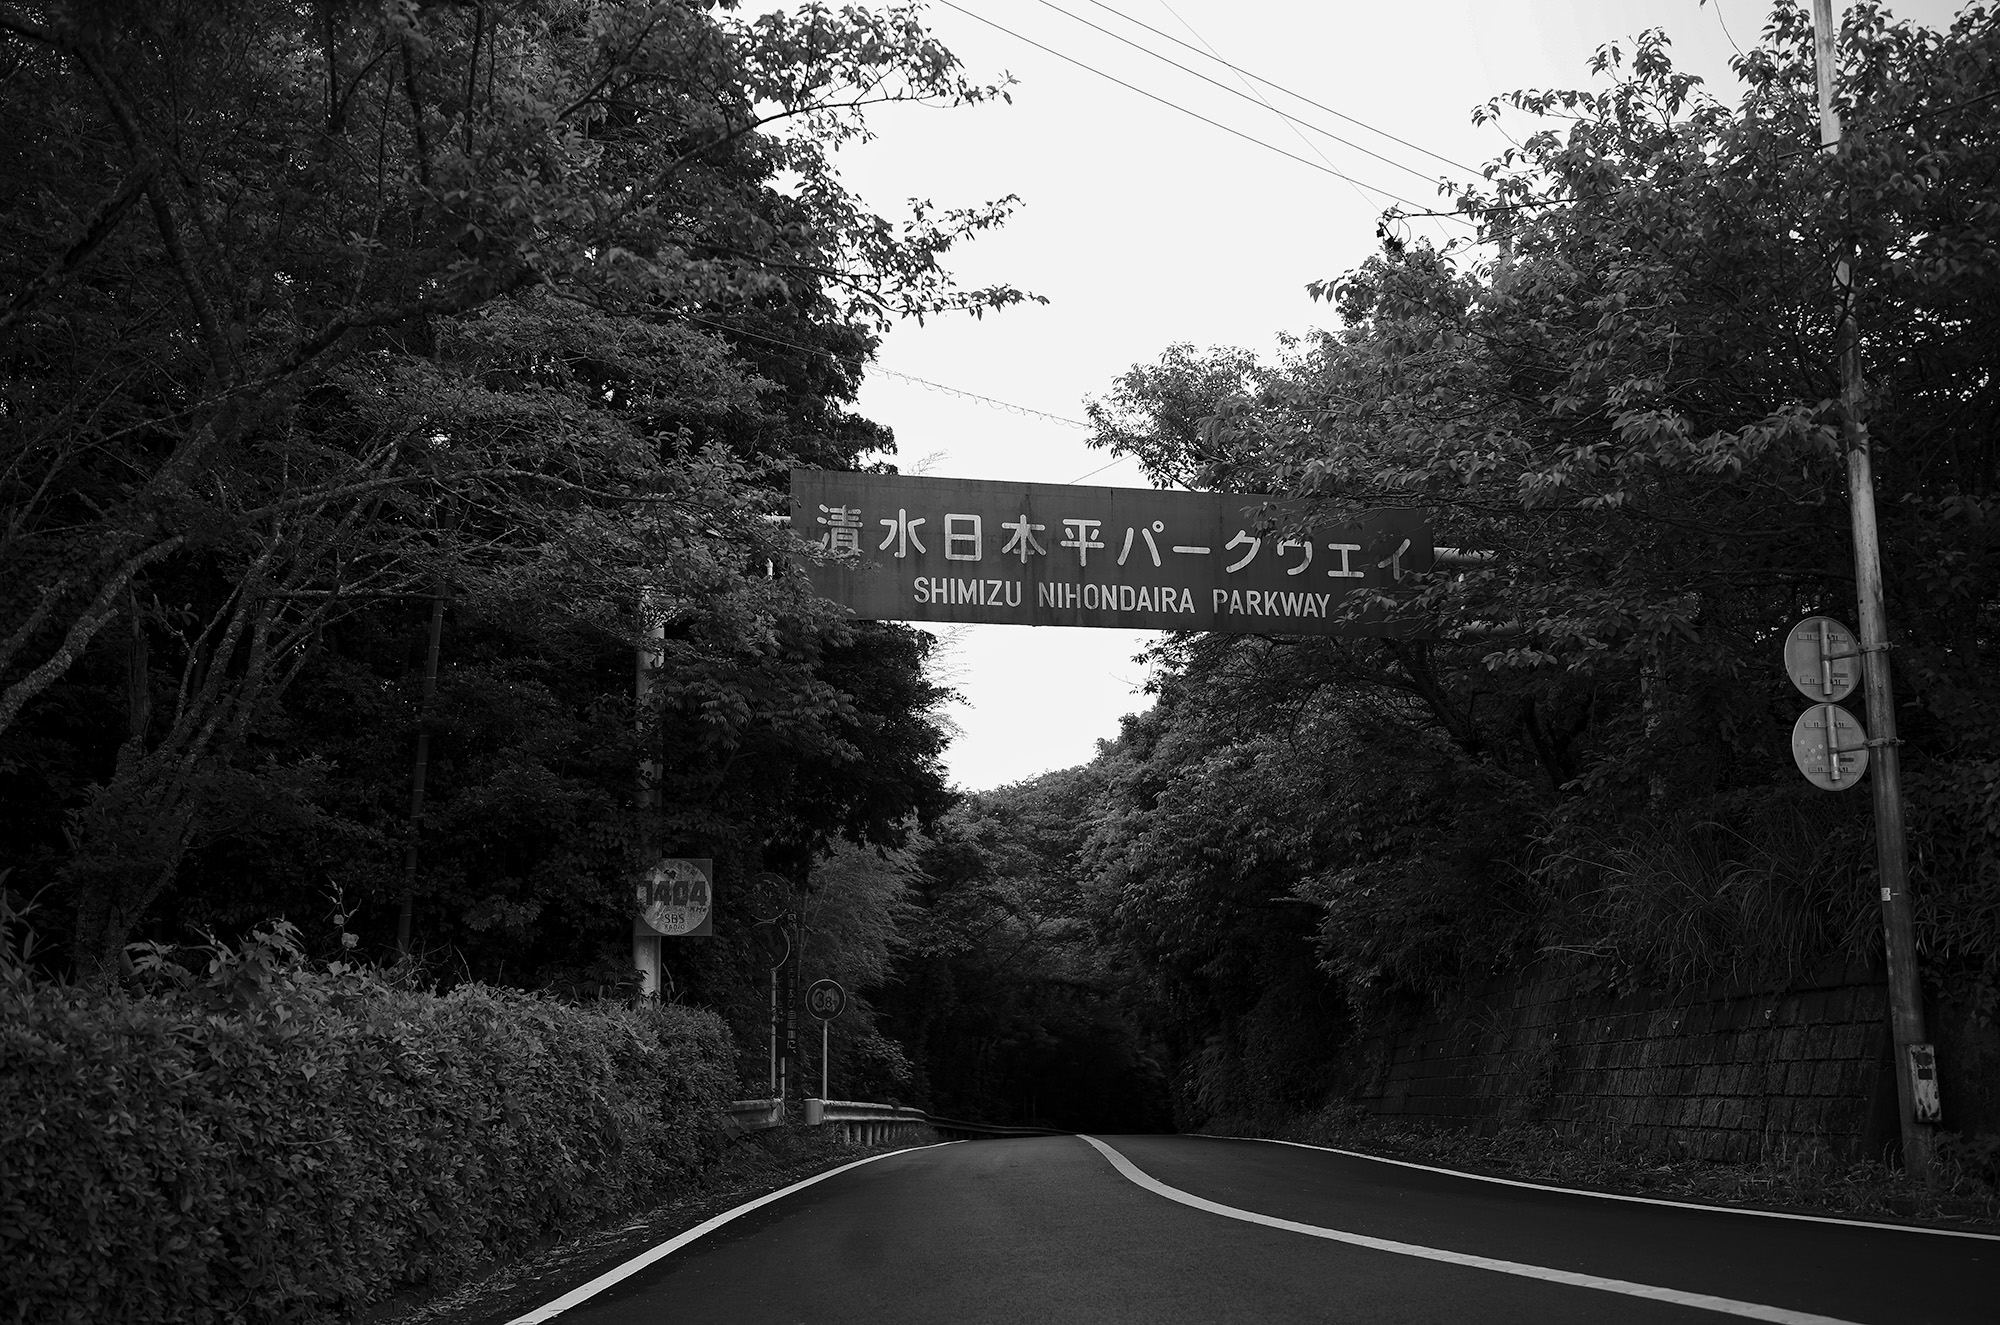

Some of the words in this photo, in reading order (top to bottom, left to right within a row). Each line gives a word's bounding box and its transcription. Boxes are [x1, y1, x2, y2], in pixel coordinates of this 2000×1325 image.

[913, 576, 1022, 607] SHIMIZU
[1038, 581, 1195, 614] NIHONDAIRA
[1212, 588, 1331, 618] PARKWAY
[645, 881, 708, 906] 1404
[665, 913, 685, 924] SBS
